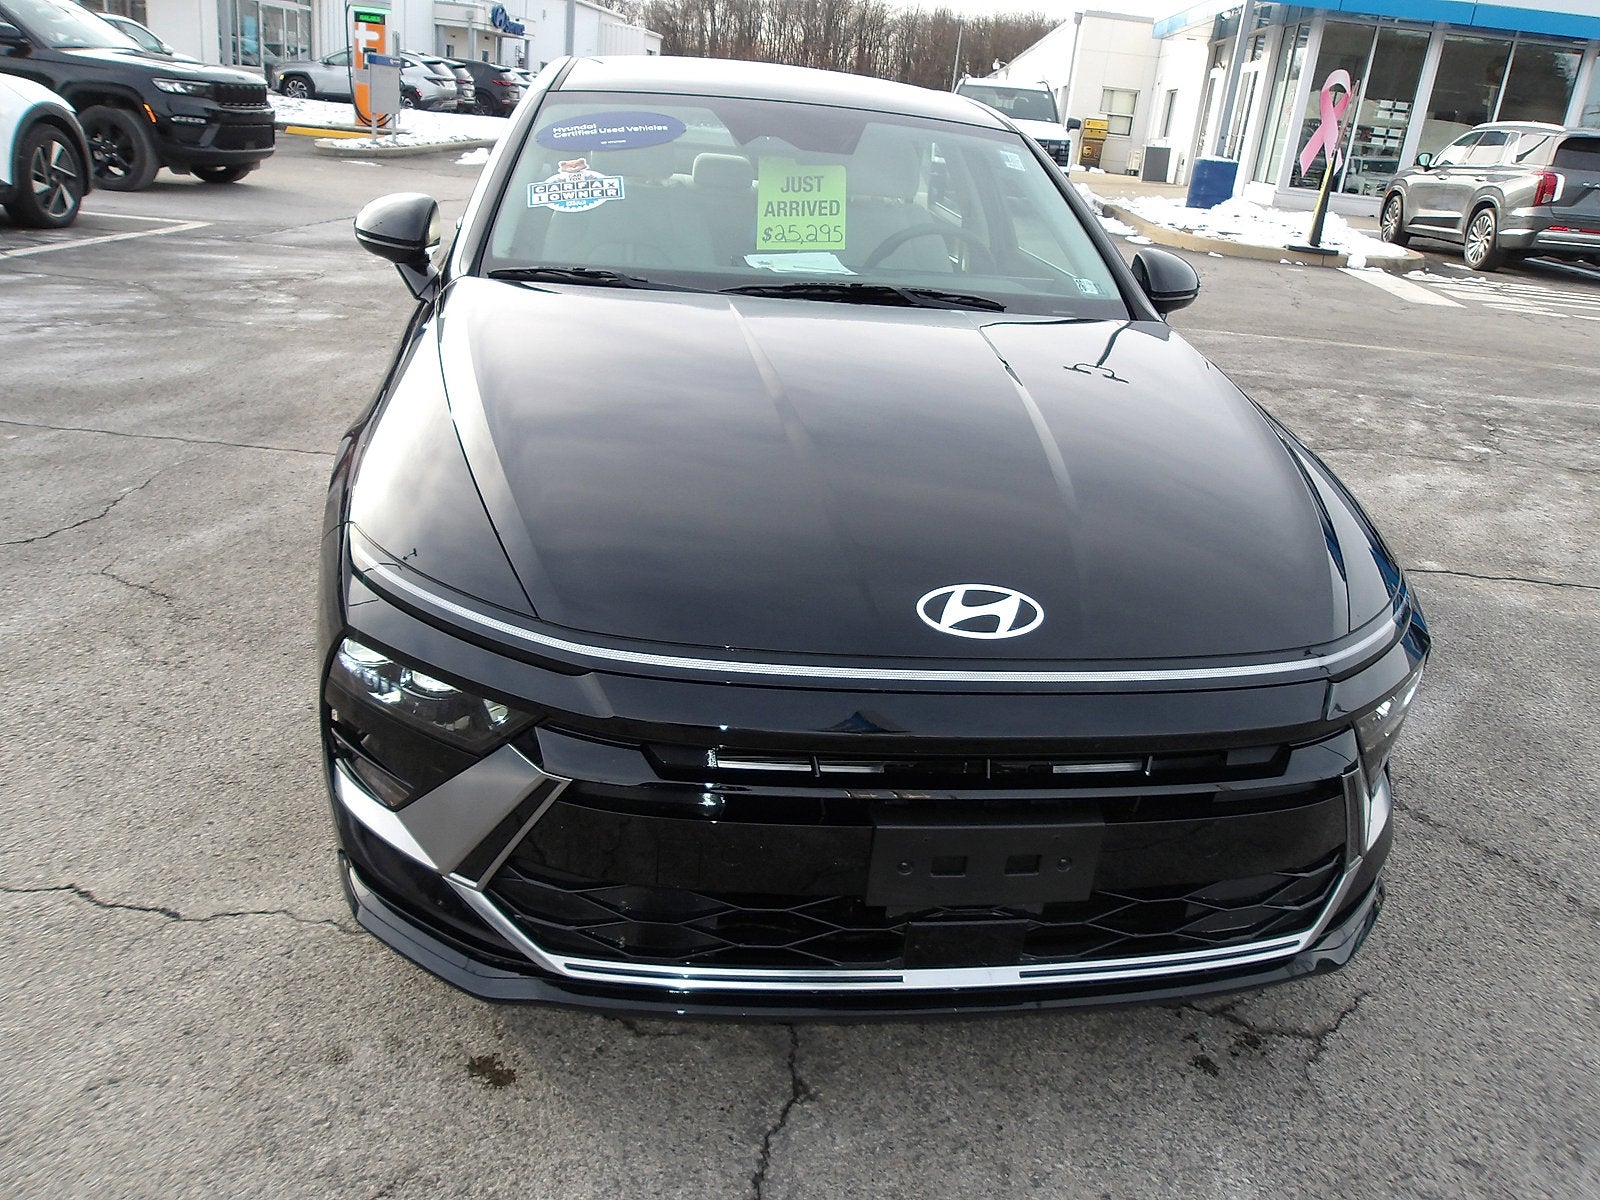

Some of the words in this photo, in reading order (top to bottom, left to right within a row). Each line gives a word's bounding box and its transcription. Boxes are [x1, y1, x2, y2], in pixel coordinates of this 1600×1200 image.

[553, 123, 596, 133] Hyundai
[553, 129, 598, 138] Certified
[599, 126, 625, 134] Used
[534, 181, 615, 193] CARFAX
[780, 175, 825, 193] JUST
[549, 188, 619, 201] OWNER
[763, 200, 841, 217] ARRIVED
[762, 223, 844, 245] $25,295
